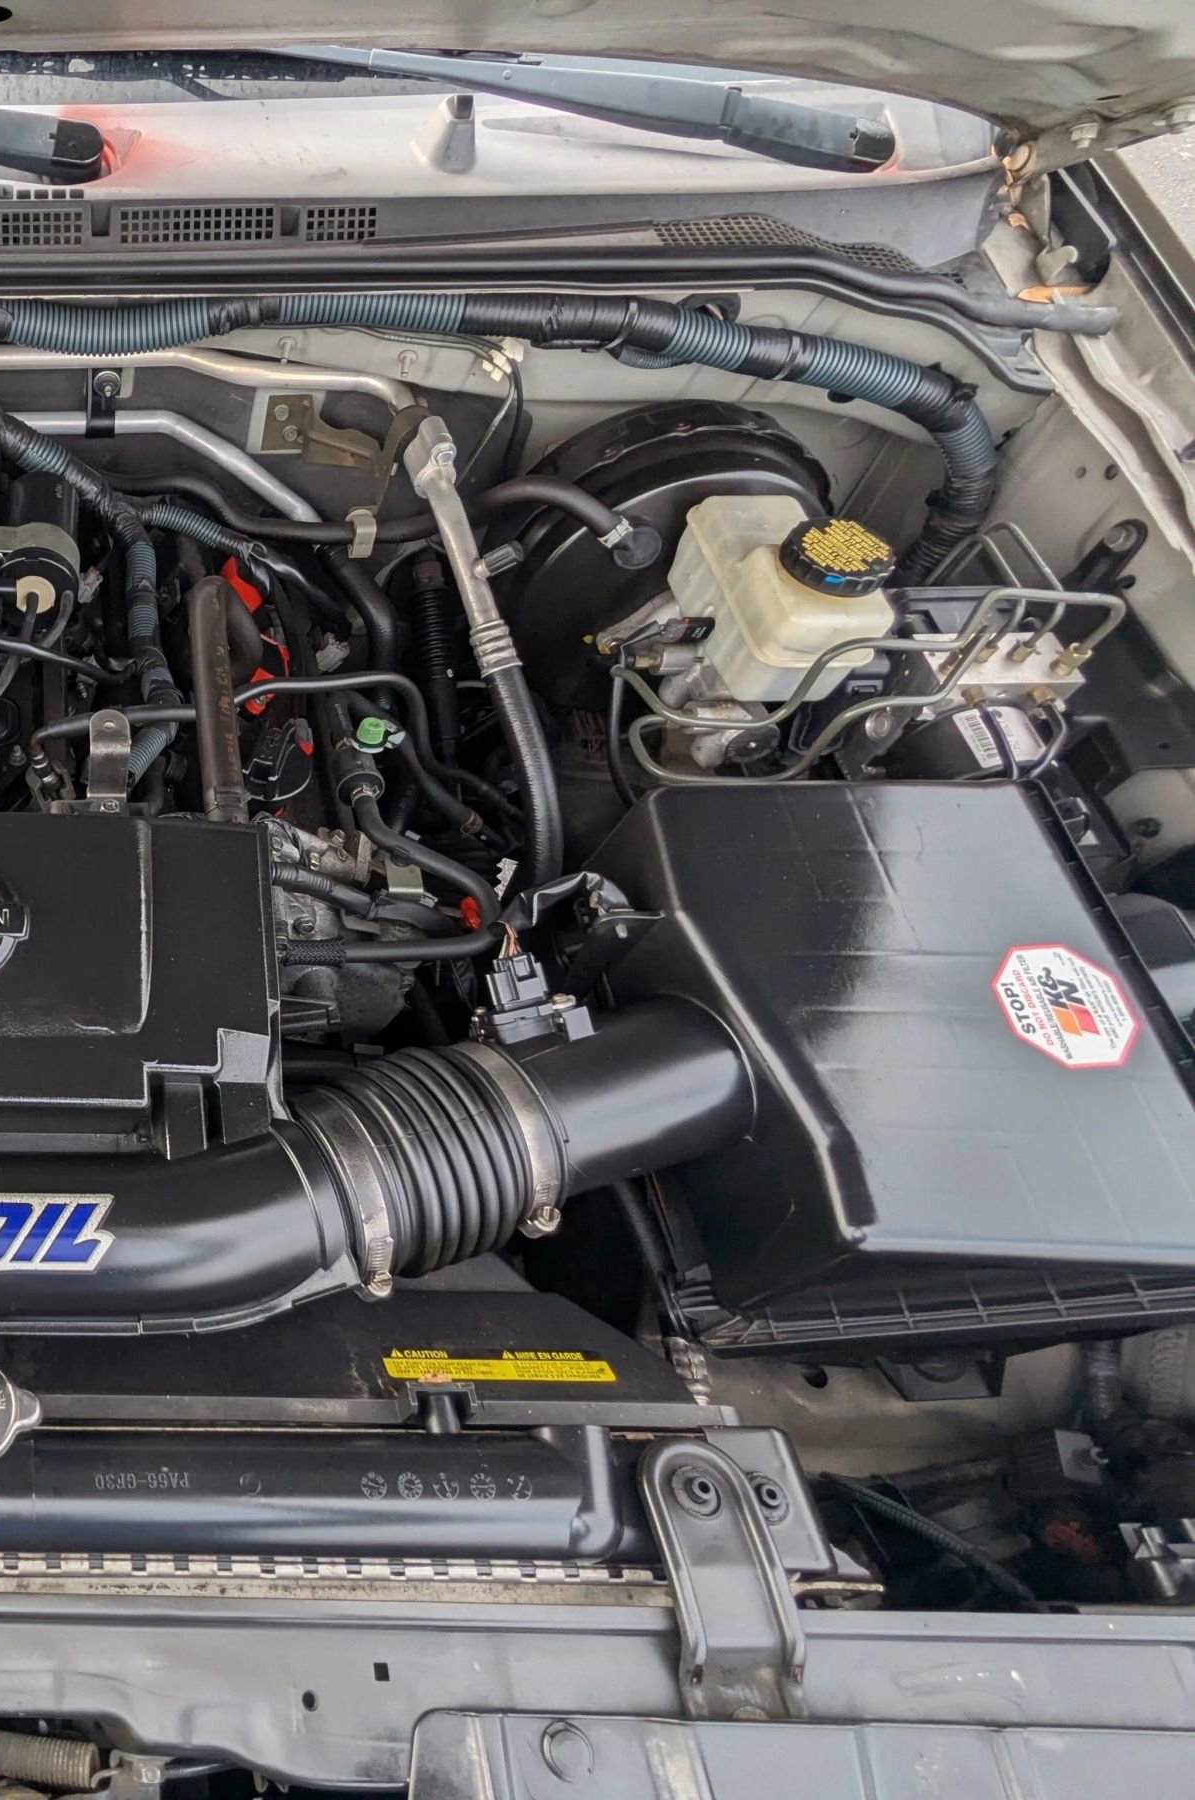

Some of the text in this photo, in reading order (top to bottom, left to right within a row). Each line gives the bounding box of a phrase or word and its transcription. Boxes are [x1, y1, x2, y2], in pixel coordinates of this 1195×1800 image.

[1000, 981, 1036, 1034] STOP!
[1011, 968, 1054, 1046] DO NOT DISCARD
[403, 1349, 449, 1359] CAUTION
[515, 1351, 584, 1361] MISE EN GARDE
